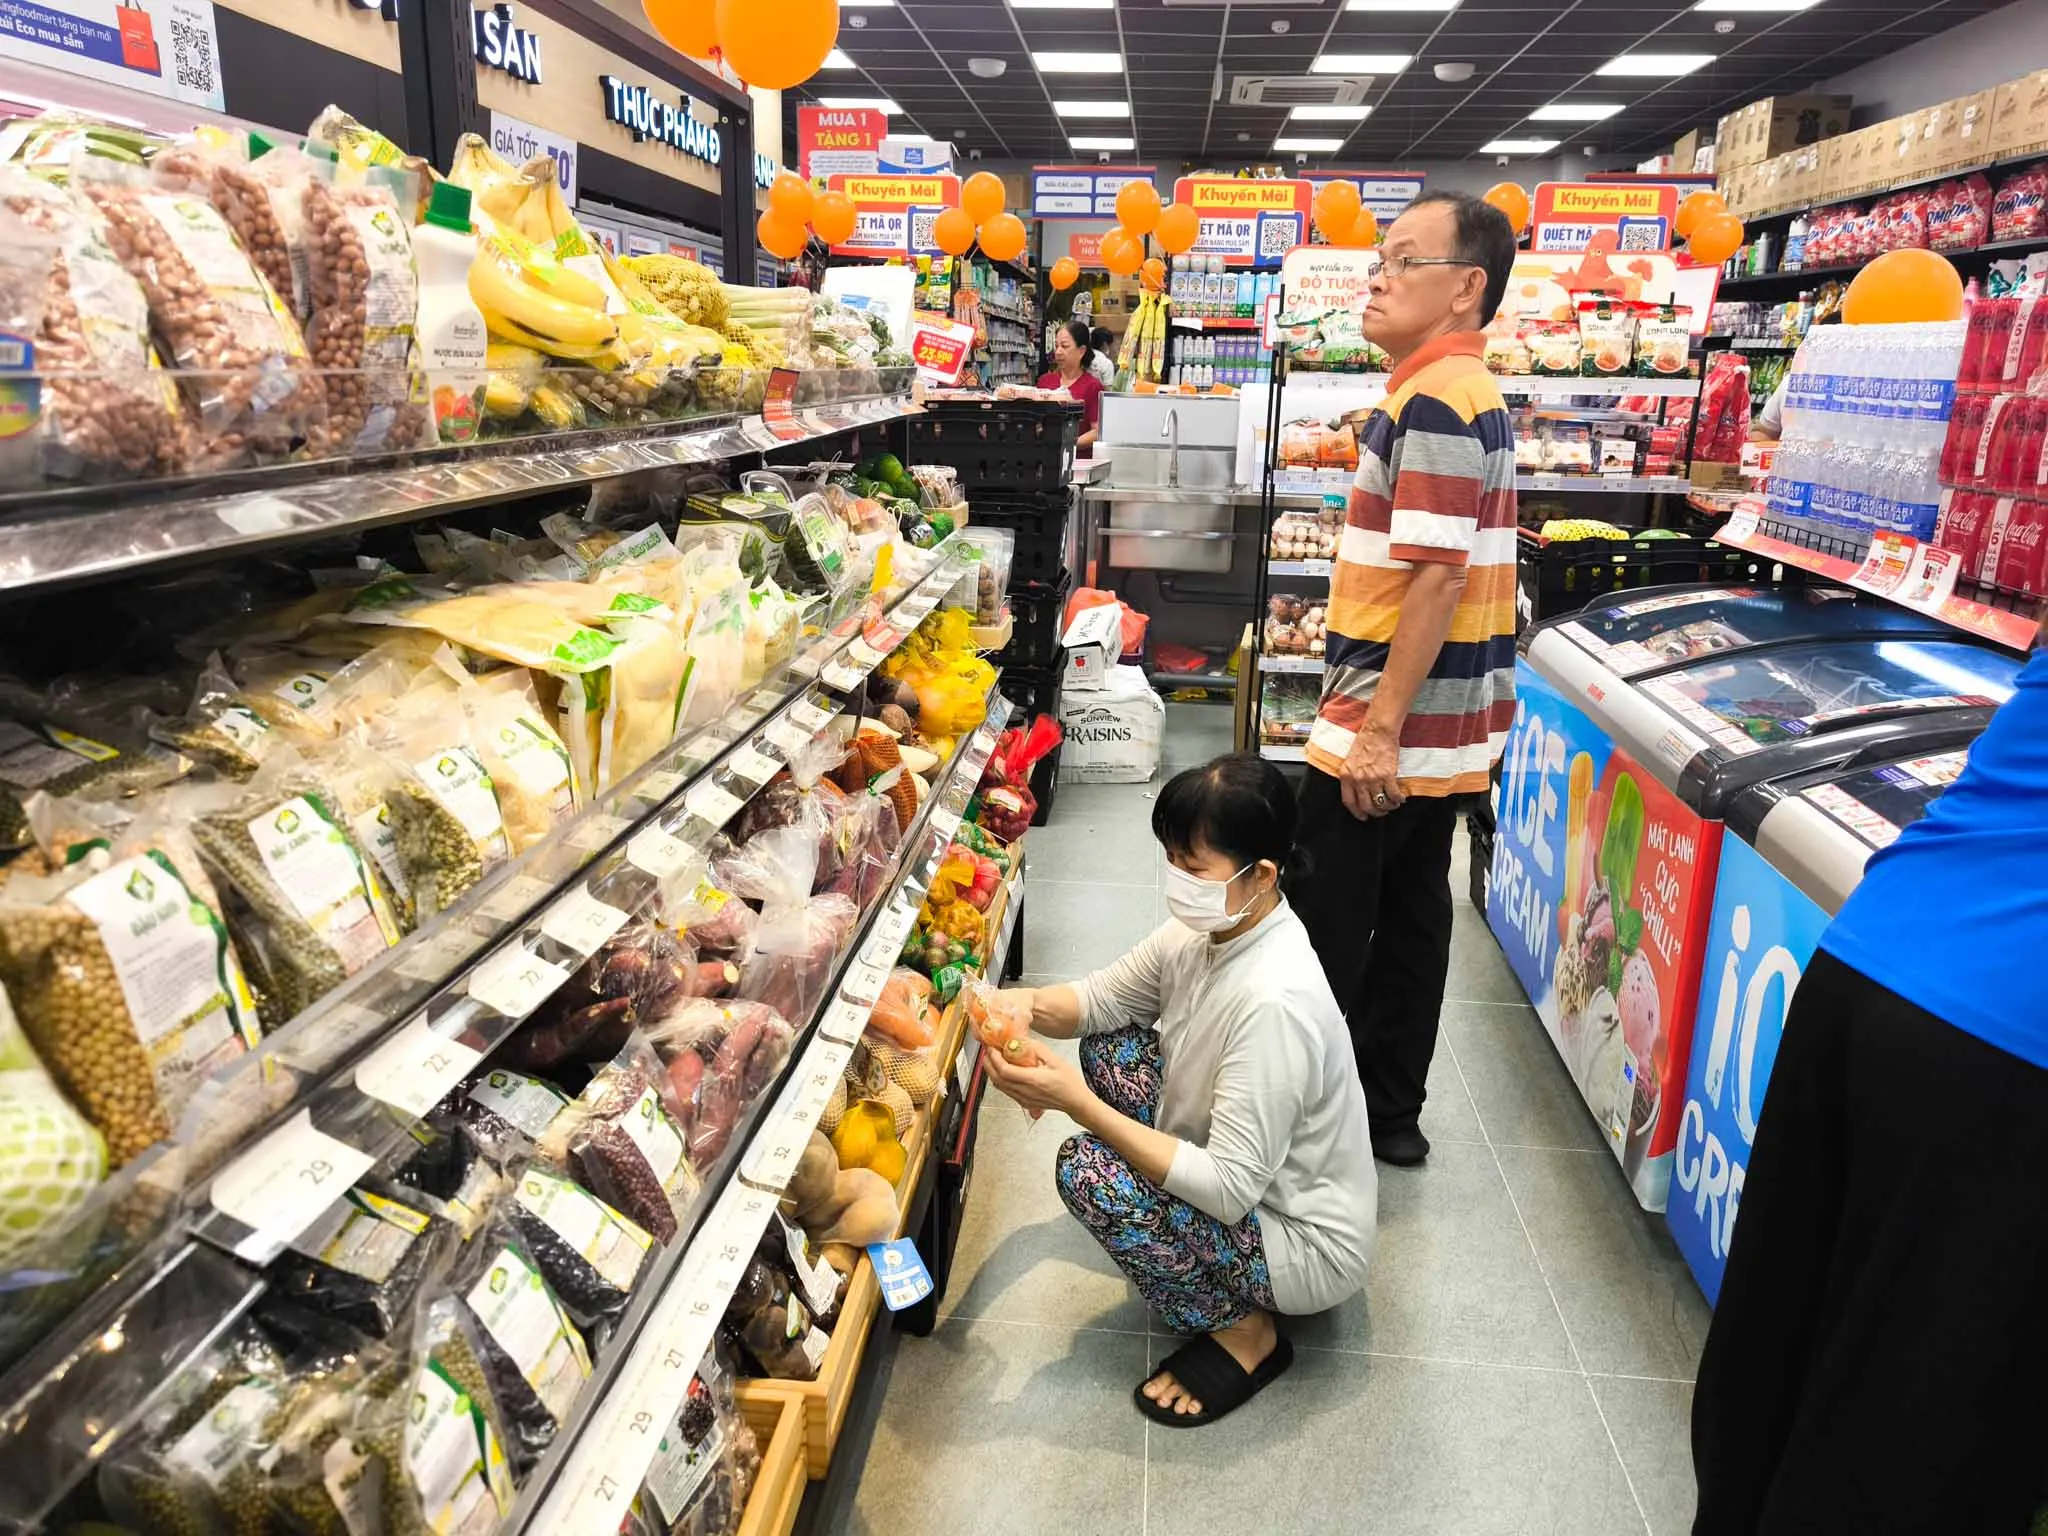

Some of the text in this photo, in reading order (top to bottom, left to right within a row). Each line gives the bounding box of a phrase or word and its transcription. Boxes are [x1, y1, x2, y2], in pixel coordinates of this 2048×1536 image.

[16, 19, 35, 36] Eco
[38, 29, 60, 43] mua
[484, 5, 542, 84] SẢN
[608, 76, 661, 141] THỰC
[664, 95, 709, 159] PHẨM
[818, 113, 867, 127] MUA 1
[495, 128, 514, 153] GIÁ
[815, 131, 871, 149] TẶNG 1
[851, 182, 906, 199] Khuyến
[1200, 186, 1256, 204] Khuyến
[1560, 191, 1620, 209] Khuyến
[888, 217, 902, 231] QR
[1217, 220, 1232, 236] MÃ
[1236, 223, 1251, 237] QR
[1544, 225, 1574, 242] QUÉT
[1080, 714, 1121, 725] SUNVIEW
[1070, 727, 1132, 745] RAISINS
[1647, 822, 1696, 867] MÁT LẠNH
[1655, 858, 1681, 913] CỰC
[1491, 830, 1551, 979] CREAM
[423, 1052, 451, 1075] 22
[299, 1158, 334, 1187] 29
[743, 1200, 762, 1214] 16
[719, 1244, 740, 1263] 26
[690, 1301, 710, 1317] 16
[663, 1348, 686, 1369] 27
[629, 1410, 653, 1435] 29
[594, 1474, 621, 1501] 27
